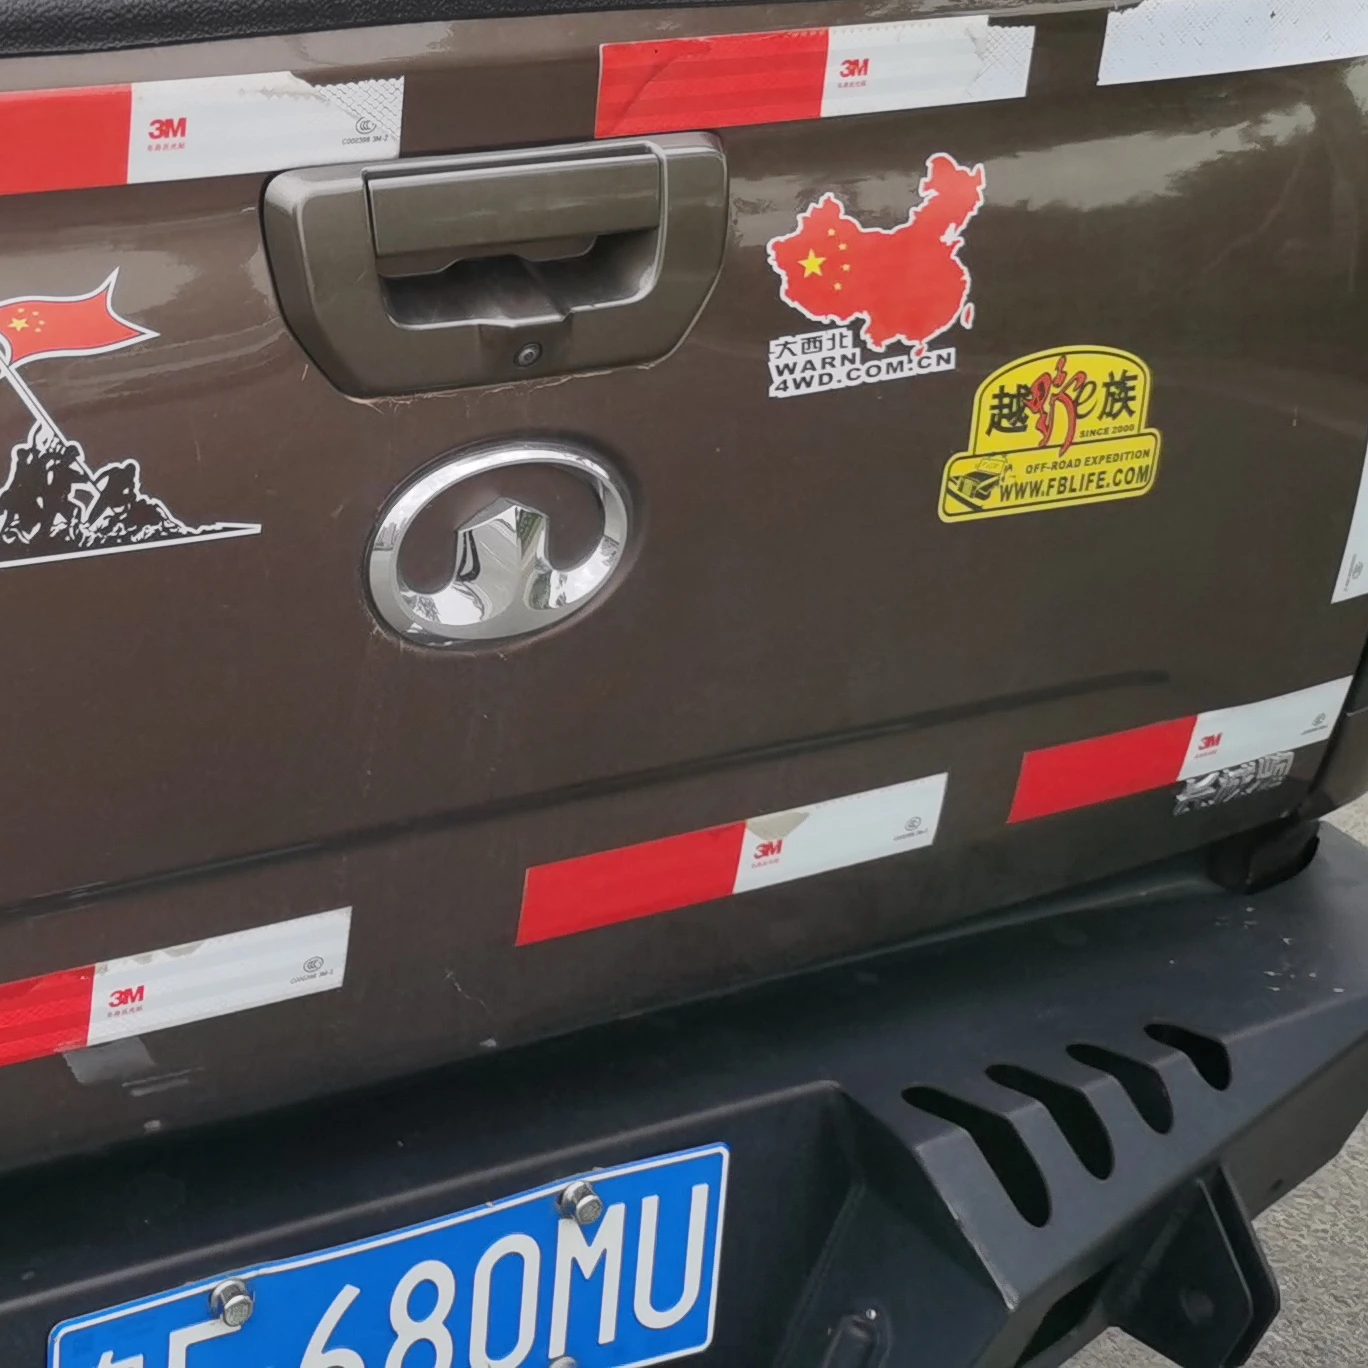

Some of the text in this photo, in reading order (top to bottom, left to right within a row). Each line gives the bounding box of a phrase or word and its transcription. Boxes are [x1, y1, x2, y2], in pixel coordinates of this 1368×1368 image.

[840, 58, 869, 78] 3M
[148, 117, 187, 139] 3M
[775, 332, 849, 359] 大西北
[774, 352, 951, 392] 4WD.COM.CN
[775, 352, 857, 377] WARN
[1079, 427, 1110, 438] SINCE
[1025, 448, 1150, 475] OFF-ROAD EXPEDITION
[999, 464, 1150, 502] WWW.FBLIFE.COM
[1198, 732, 1222, 750] 3M
[753, 839, 782, 859] 3M
[108, 985, 145, 1007] 3M
[98, 1184, 709, 1368] 680MU
